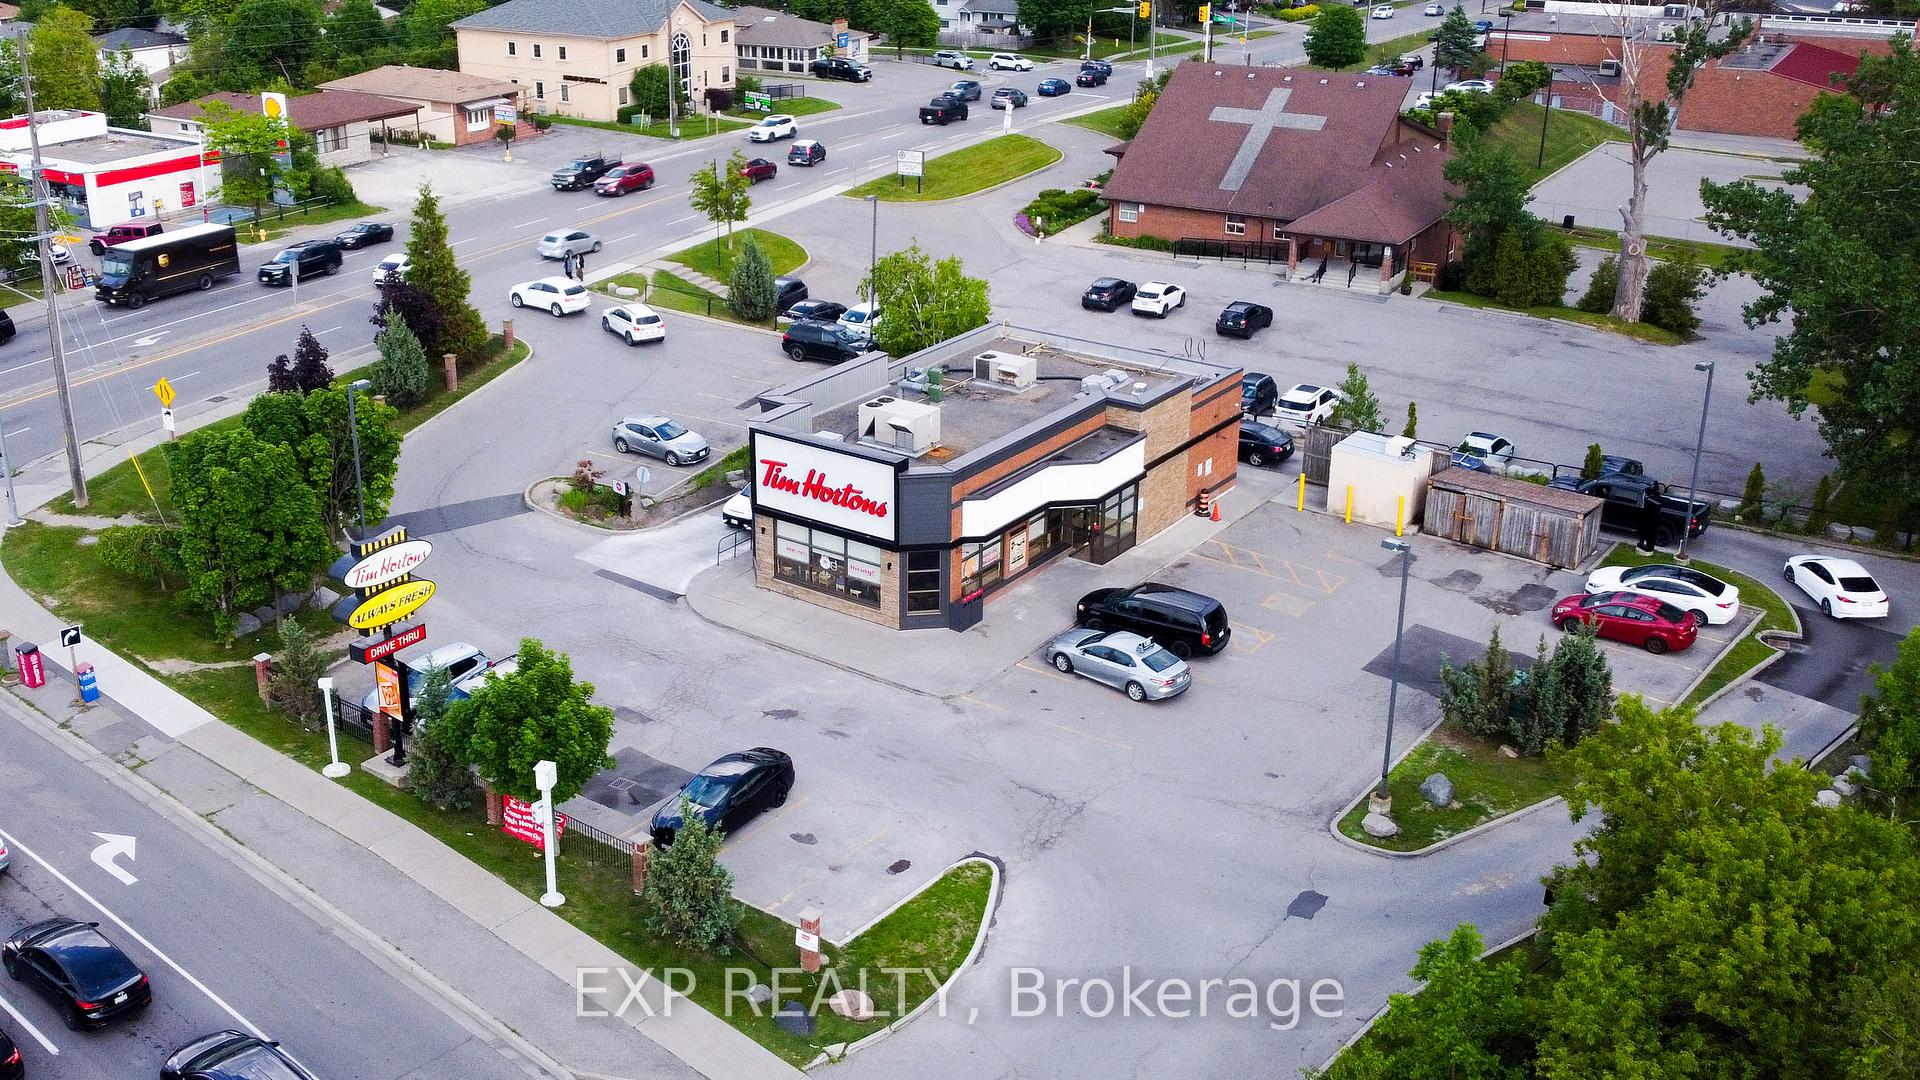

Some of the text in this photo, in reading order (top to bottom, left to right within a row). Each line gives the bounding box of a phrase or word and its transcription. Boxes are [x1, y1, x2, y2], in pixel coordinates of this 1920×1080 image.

[760, 459, 887, 517] Tim Hortons
[353, 551, 426, 586] Tim Hortons
[353, 584, 433, 626] ALWAYS FRESH
[370, 629, 421, 659] DRIVE THRU
